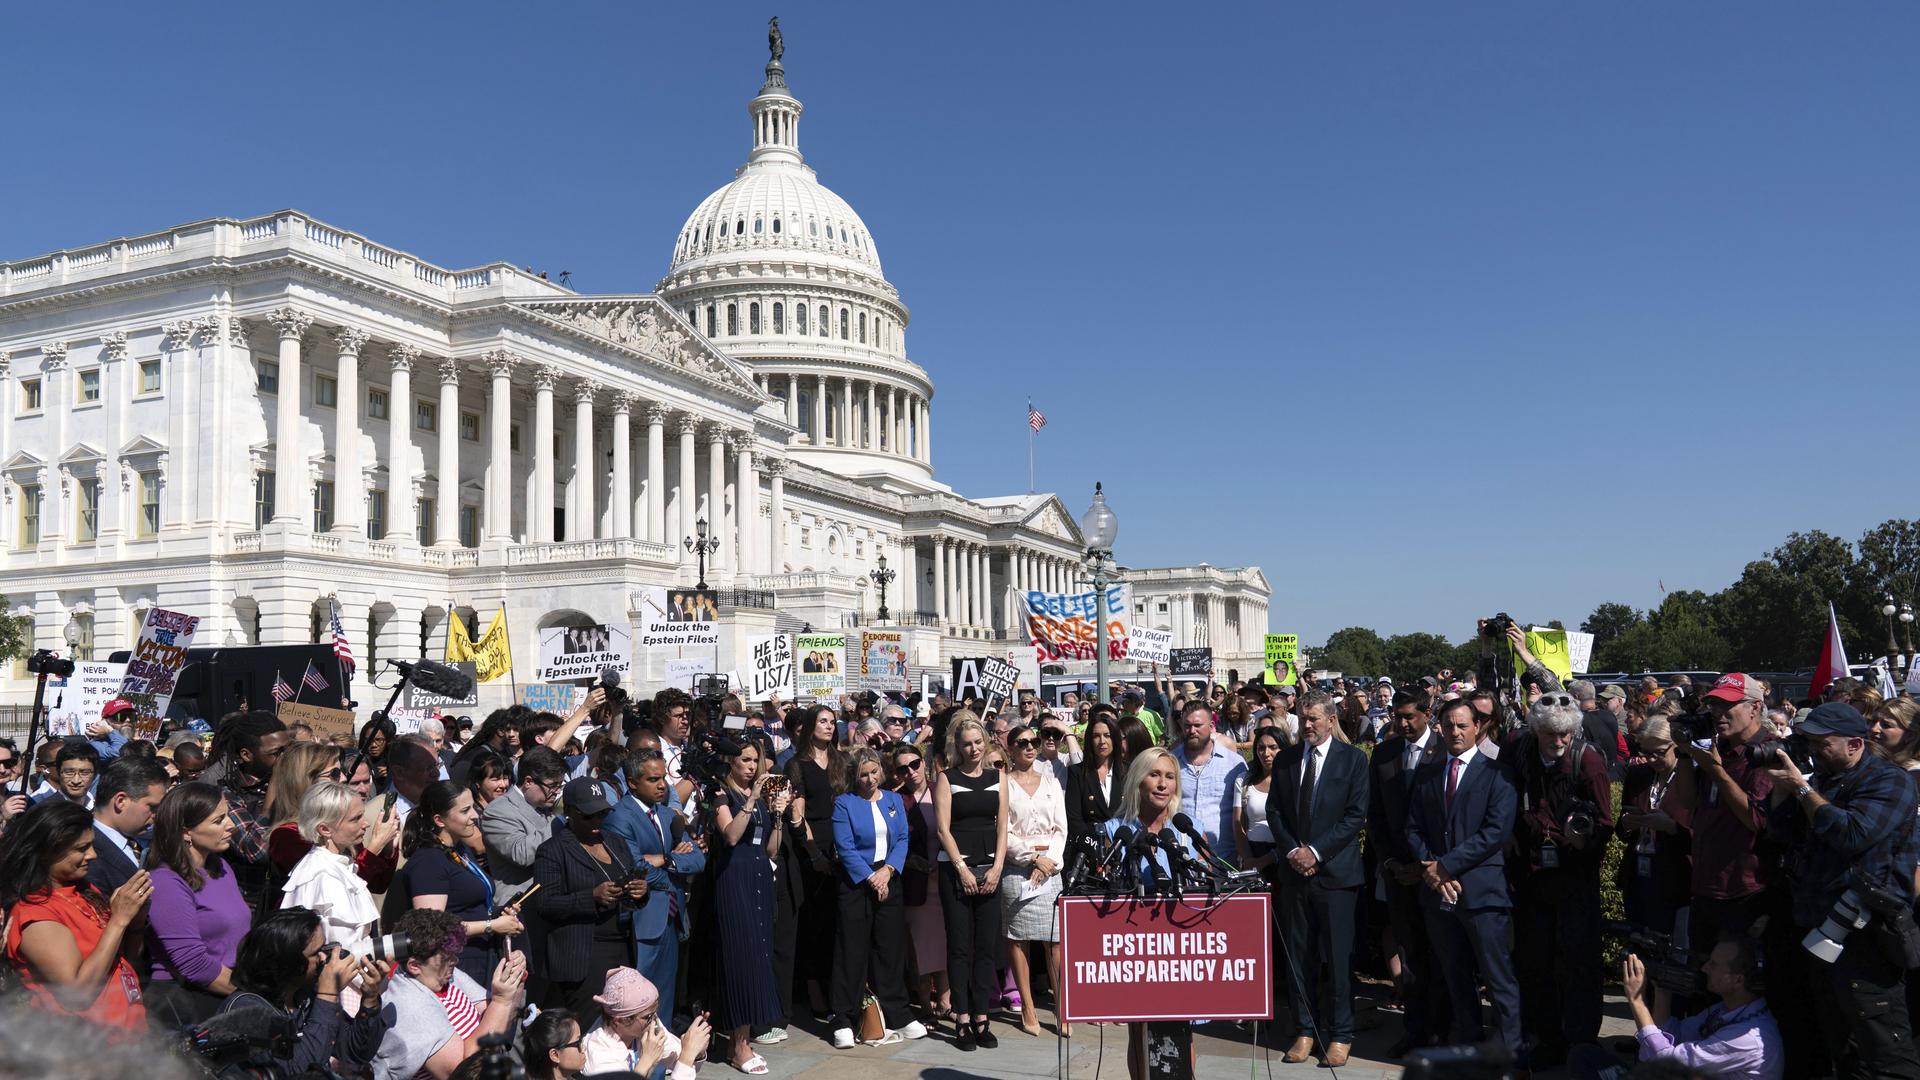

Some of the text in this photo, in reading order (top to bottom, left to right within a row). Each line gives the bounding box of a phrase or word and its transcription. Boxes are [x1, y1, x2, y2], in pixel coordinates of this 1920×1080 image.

[650, 623, 710, 632] Unlock the
[643, 635, 718, 646] Epstein Files!
[797, 637, 845, 647] FRIENDS
[863, 631, 901, 641] PEDOPHILE
[1132, 628, 1172, 643] DO RIGHT
[754, 635, 786, 660] HE IS
[554, 652, 621, 666] Unlock the
[757, 650, 790, 670] ON the
[1127, 648, 1169, 662] WRONGED
[83, 666, 107, 674] NEVER
[545, 665, 592, 679] Epstein
[984, 658, 1019, 684] RELEASE
[755, 663, 792, 695] LIST!
[799, 681, 825, 689] EPSTEIN
[984, 674, 1012, 697] FILES
[525, 684, 574, 698] BELIEVE
[280, 702, 311, 719] Believe
[1102, 932, 1228, 956] EPSTEIN FILES
[1074, 958, 1256, 984] TRANSPARENCY ACT
